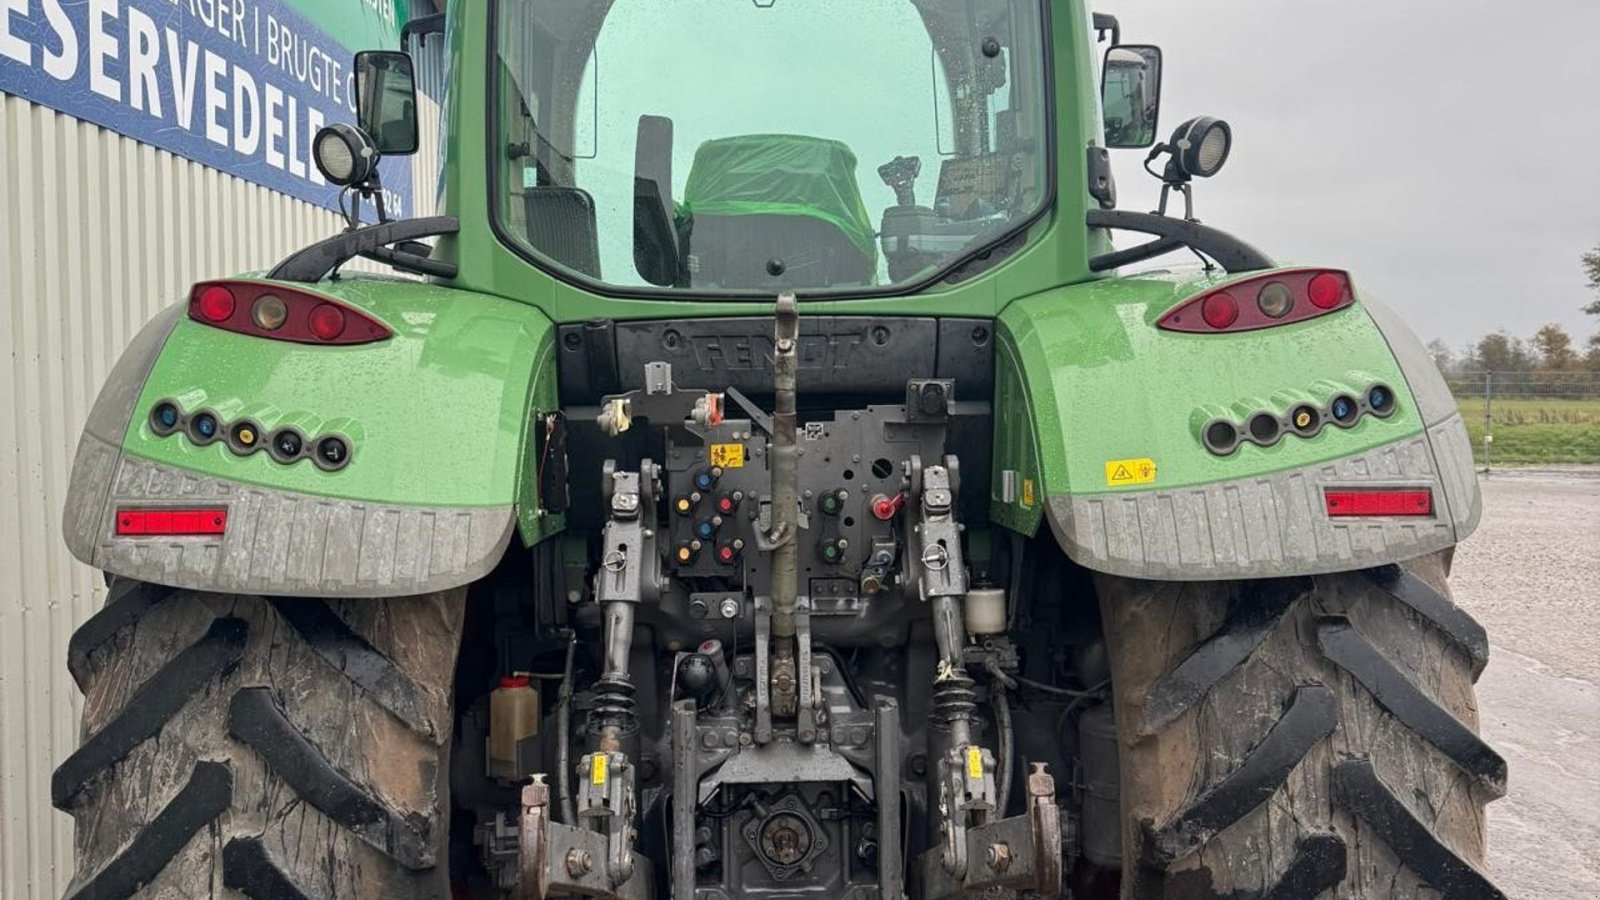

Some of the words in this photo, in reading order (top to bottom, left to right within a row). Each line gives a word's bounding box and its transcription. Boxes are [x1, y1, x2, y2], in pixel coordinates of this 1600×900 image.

[255, 5, 261, 55] I
[267, 14, 341, 104] BRUGTE
[690, 333, 863, 371] FENDT
